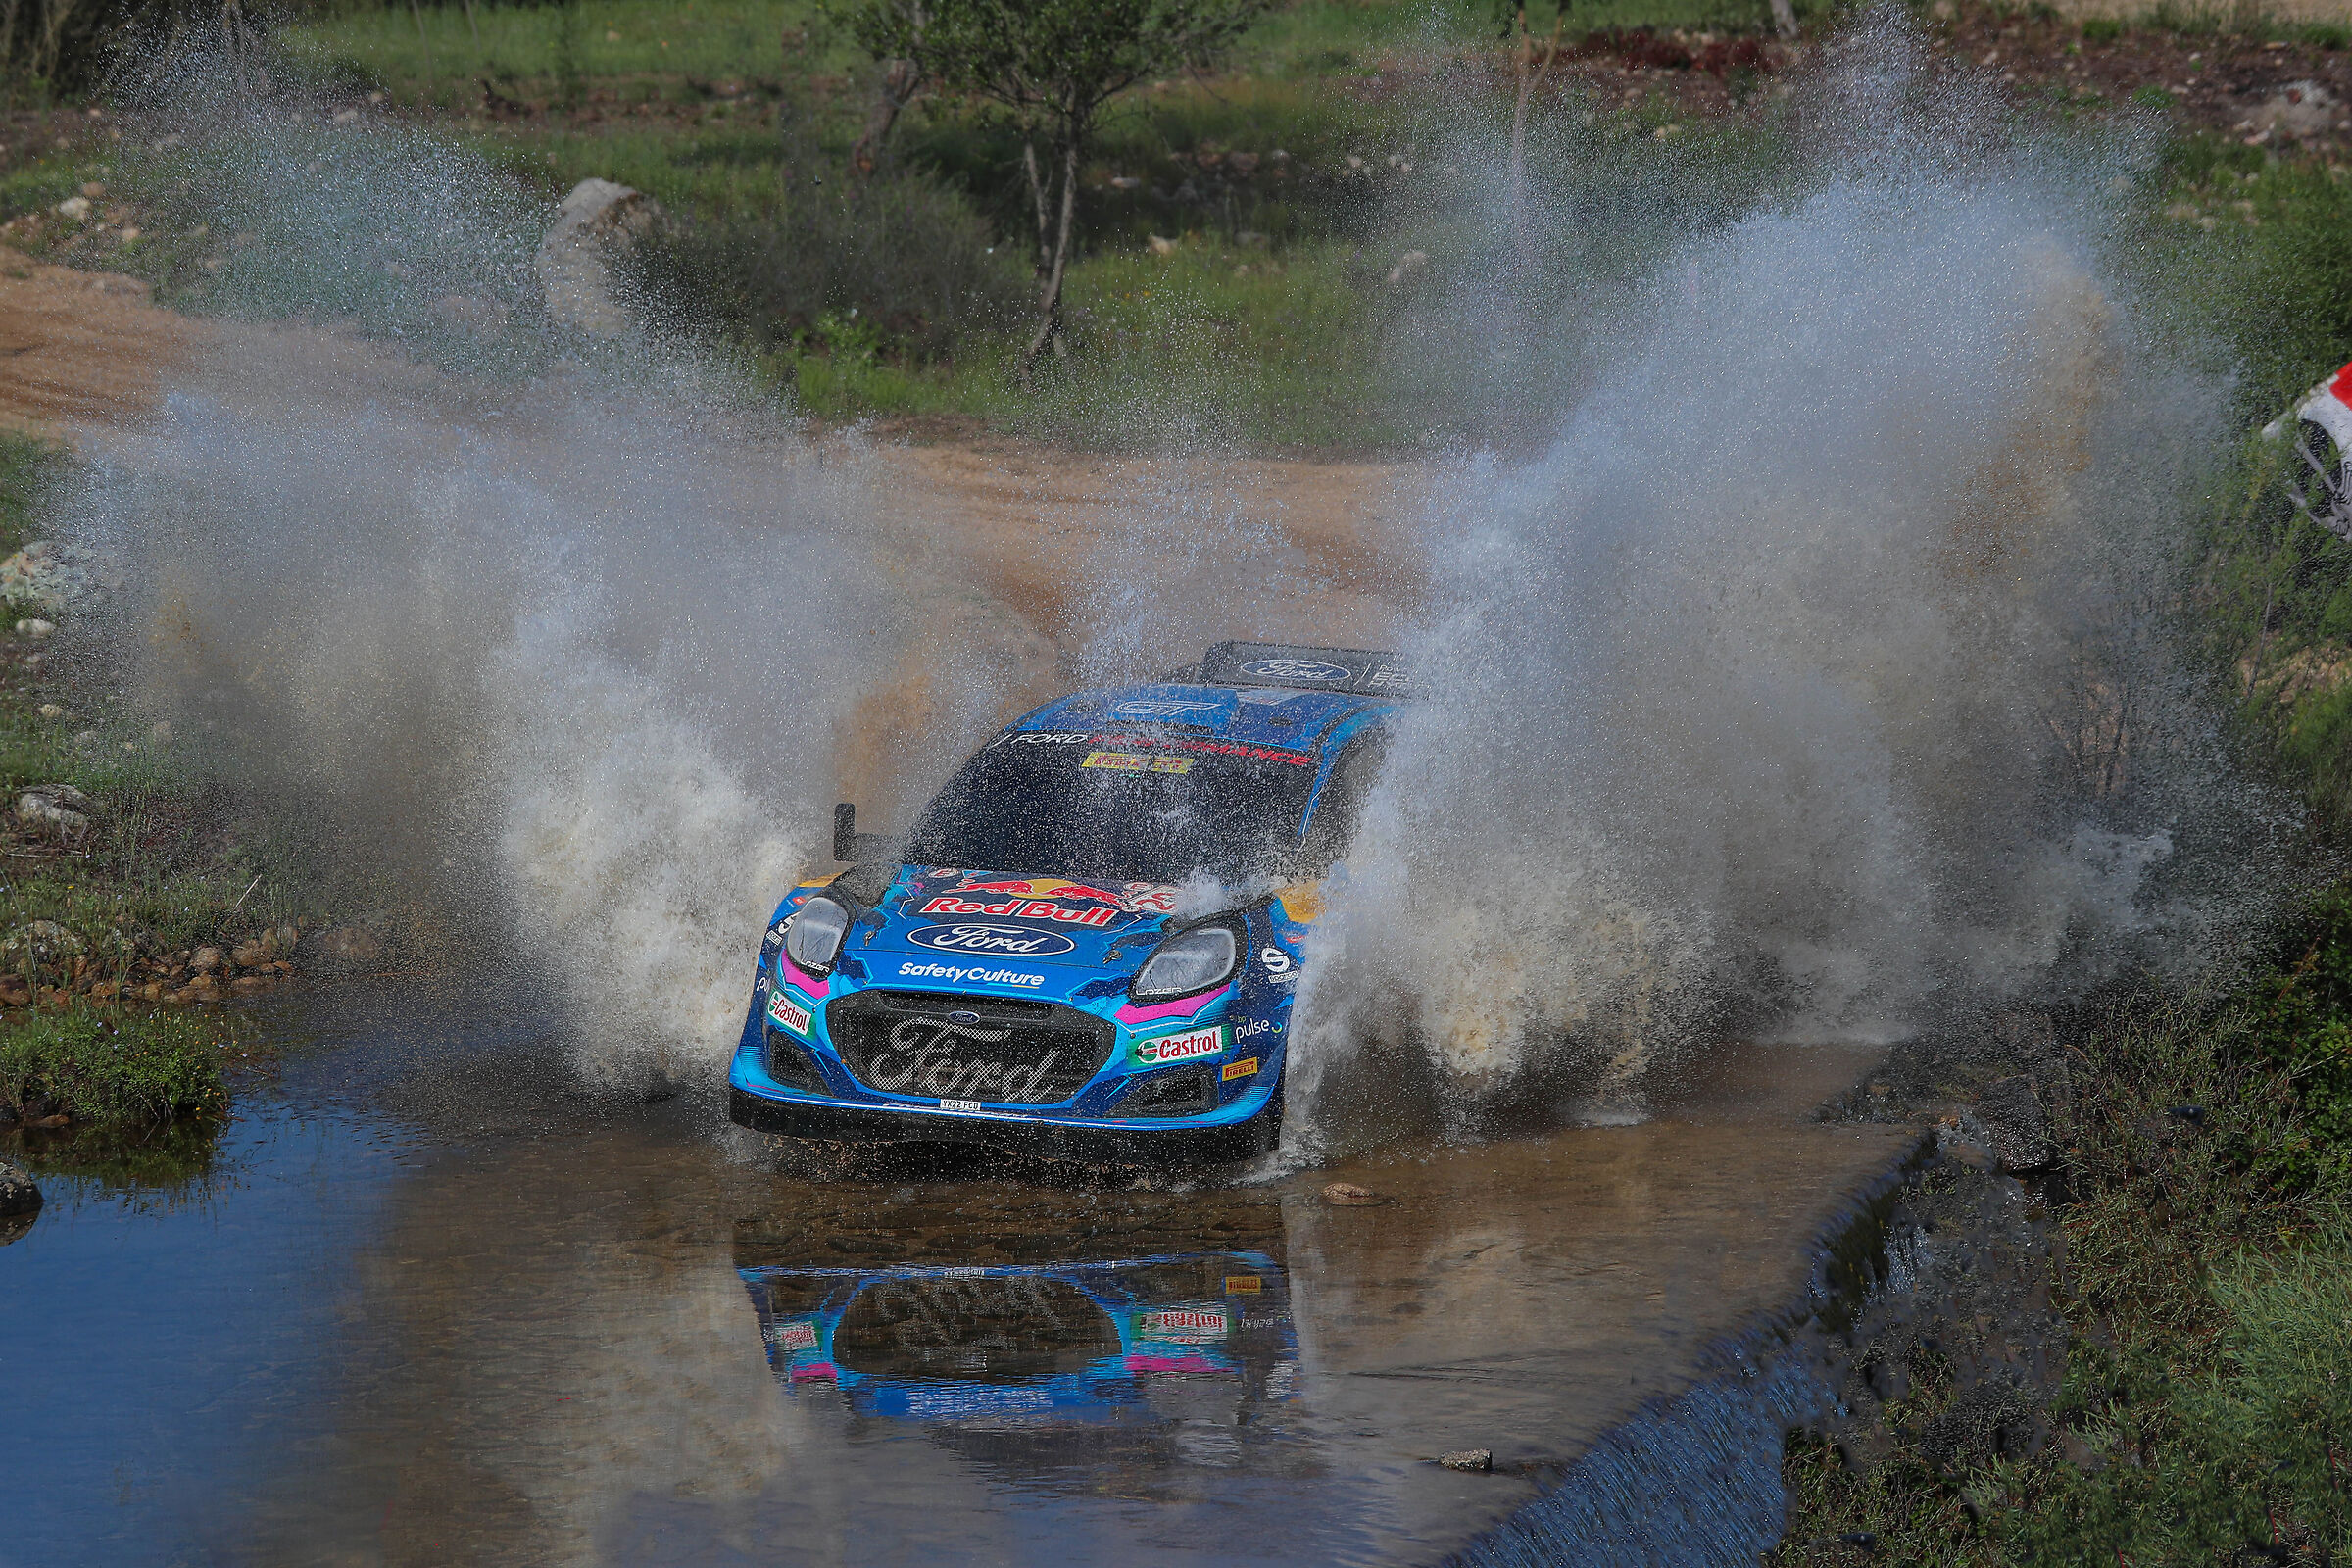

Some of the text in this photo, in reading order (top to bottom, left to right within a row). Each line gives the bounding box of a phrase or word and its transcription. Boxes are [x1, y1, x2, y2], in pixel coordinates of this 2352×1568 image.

[1257, 661, 1333, 679] Ford
[1012, 733, 1087, 745] FORD
[919, 897, 1020, 917] Red
[1013, 900, 1120, 926] Bull
[933, 925, 1049, 954] Ford
[898, 961, 1045, 986] SafetyCulture
[774, 997, 808, 1032] Castrol
[1159, 1030, 1219, 1059] Castrol
[1235, 1017, 1270, 1044] pulse
[869, 1016, 1060, 1102] Ford
[1225, 1060, 1255, 1078] PIRELLI
